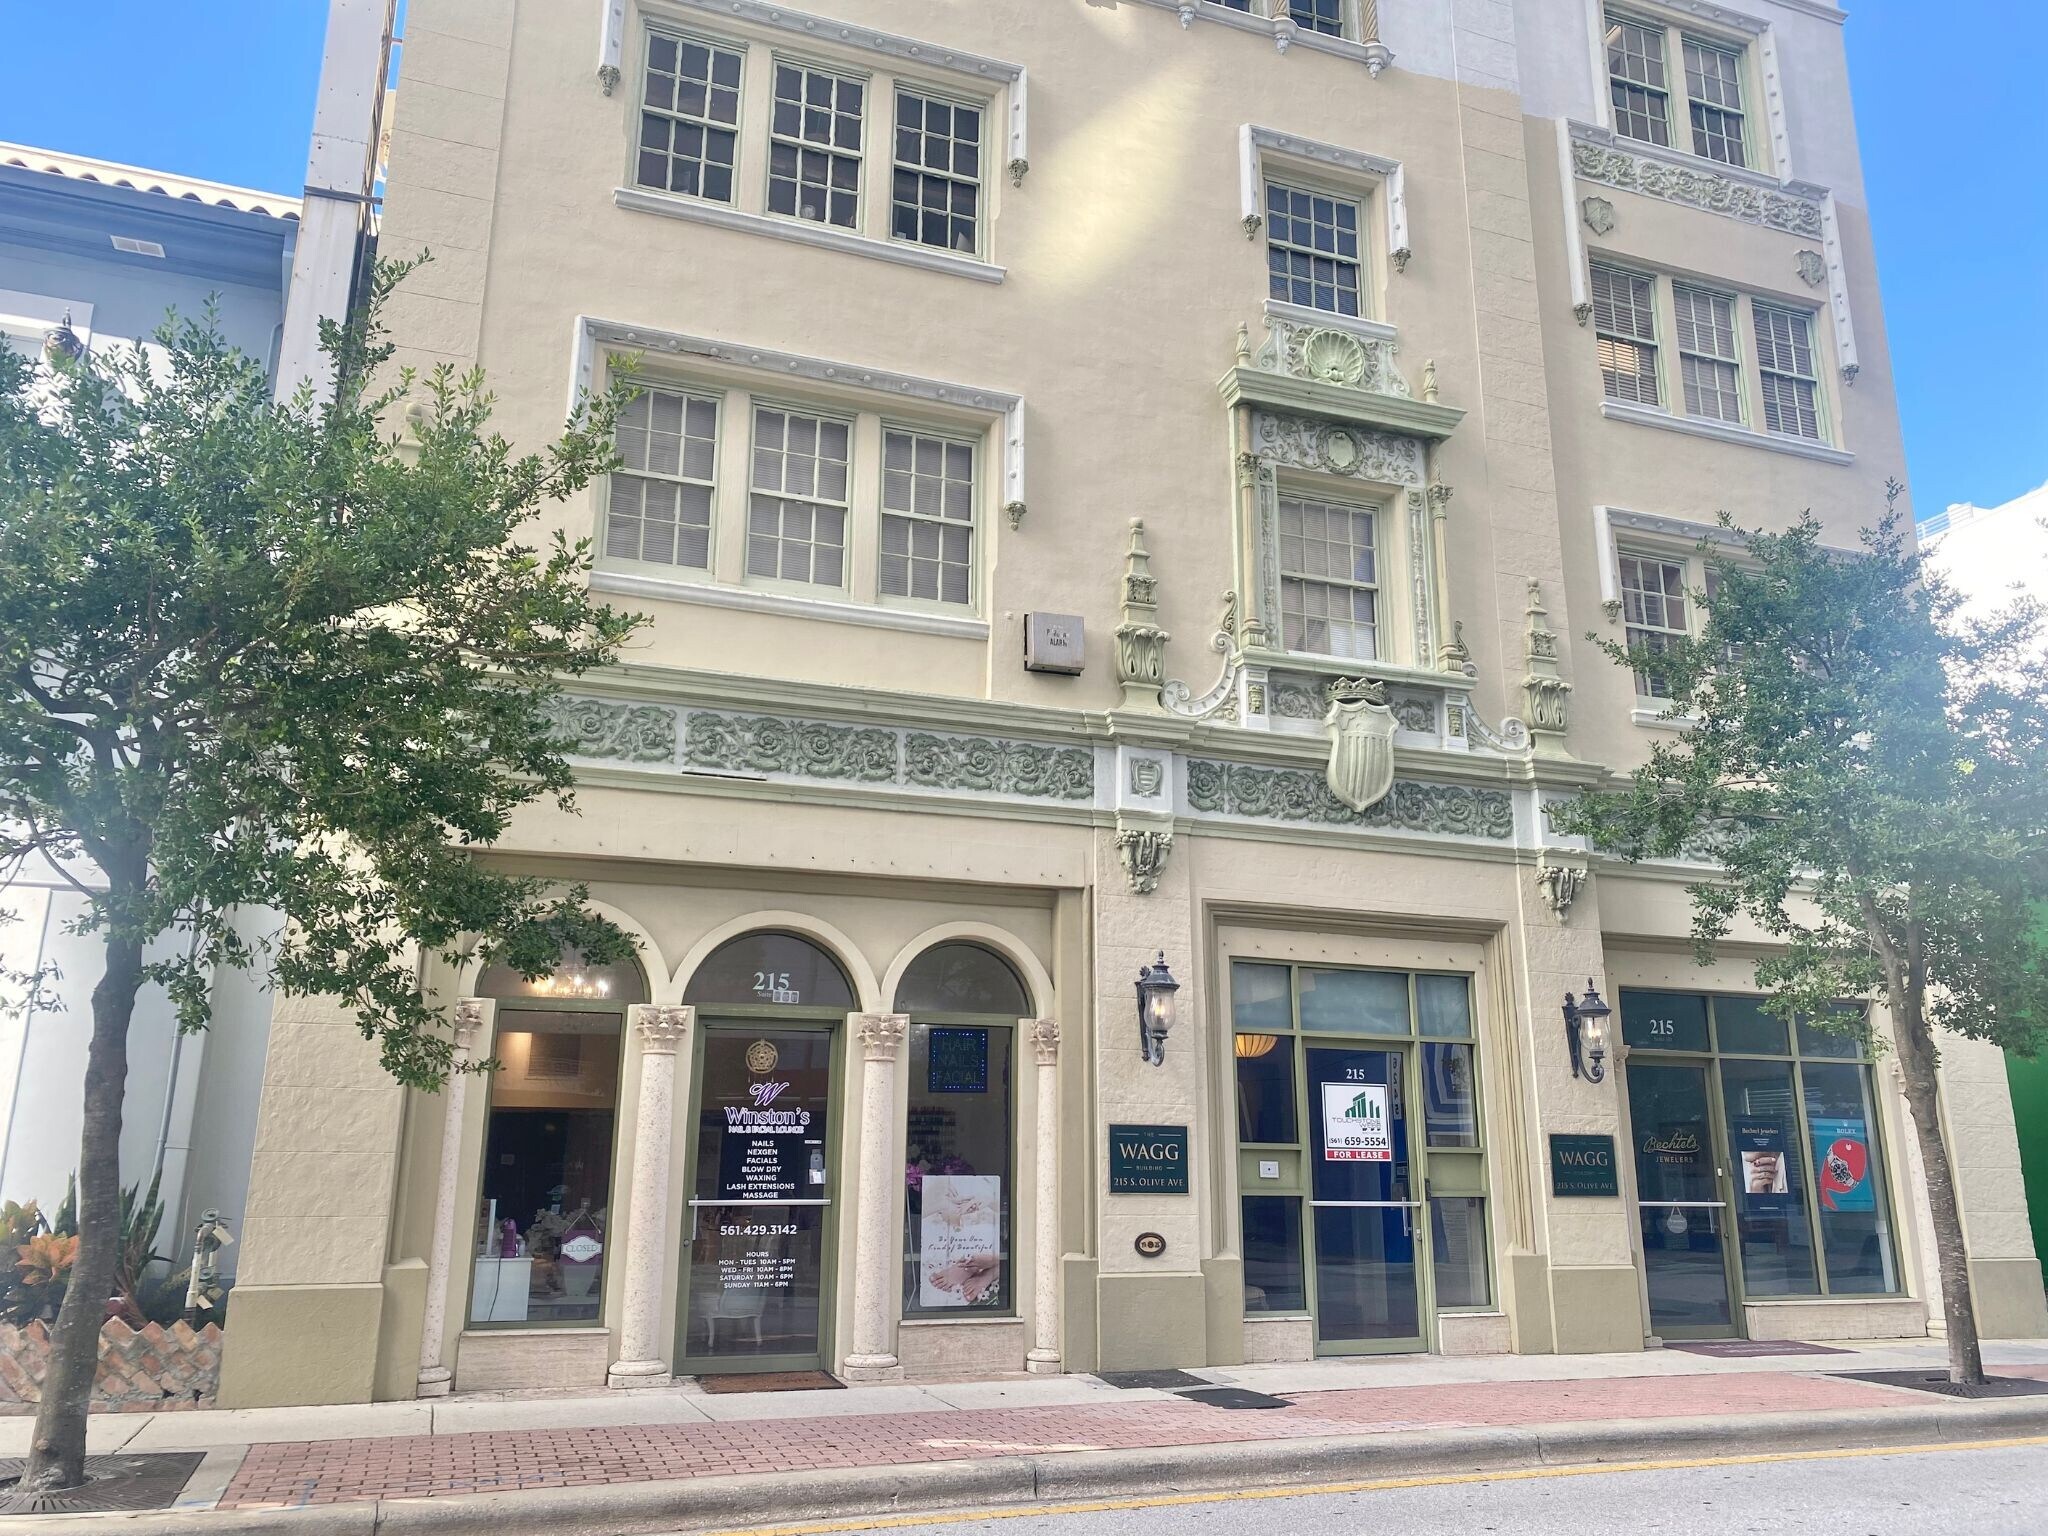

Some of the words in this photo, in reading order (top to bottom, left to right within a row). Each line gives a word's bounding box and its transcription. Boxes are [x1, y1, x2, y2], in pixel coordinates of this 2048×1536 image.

[752, 972, 790, 992] 215
[1650, 1020, 1674, 1034] 215
[1346, 1068, 1365, 1080] 215
[724, 1106, 810, 1126] Winston's
[1344, 1137, 1386, 1146] 659-5554
[1120, 1143, 1179, 1160] WAGG
[1559, 1152, 1608, 1166] WAGG
[1114, 1178, 1127, 1186] 215
[1139, 1178, 1165, 1186] OLIVE
[720, 1225, 797, 1235] 561.429.3142
[566, 1244, 597, 1253] CLOSED
